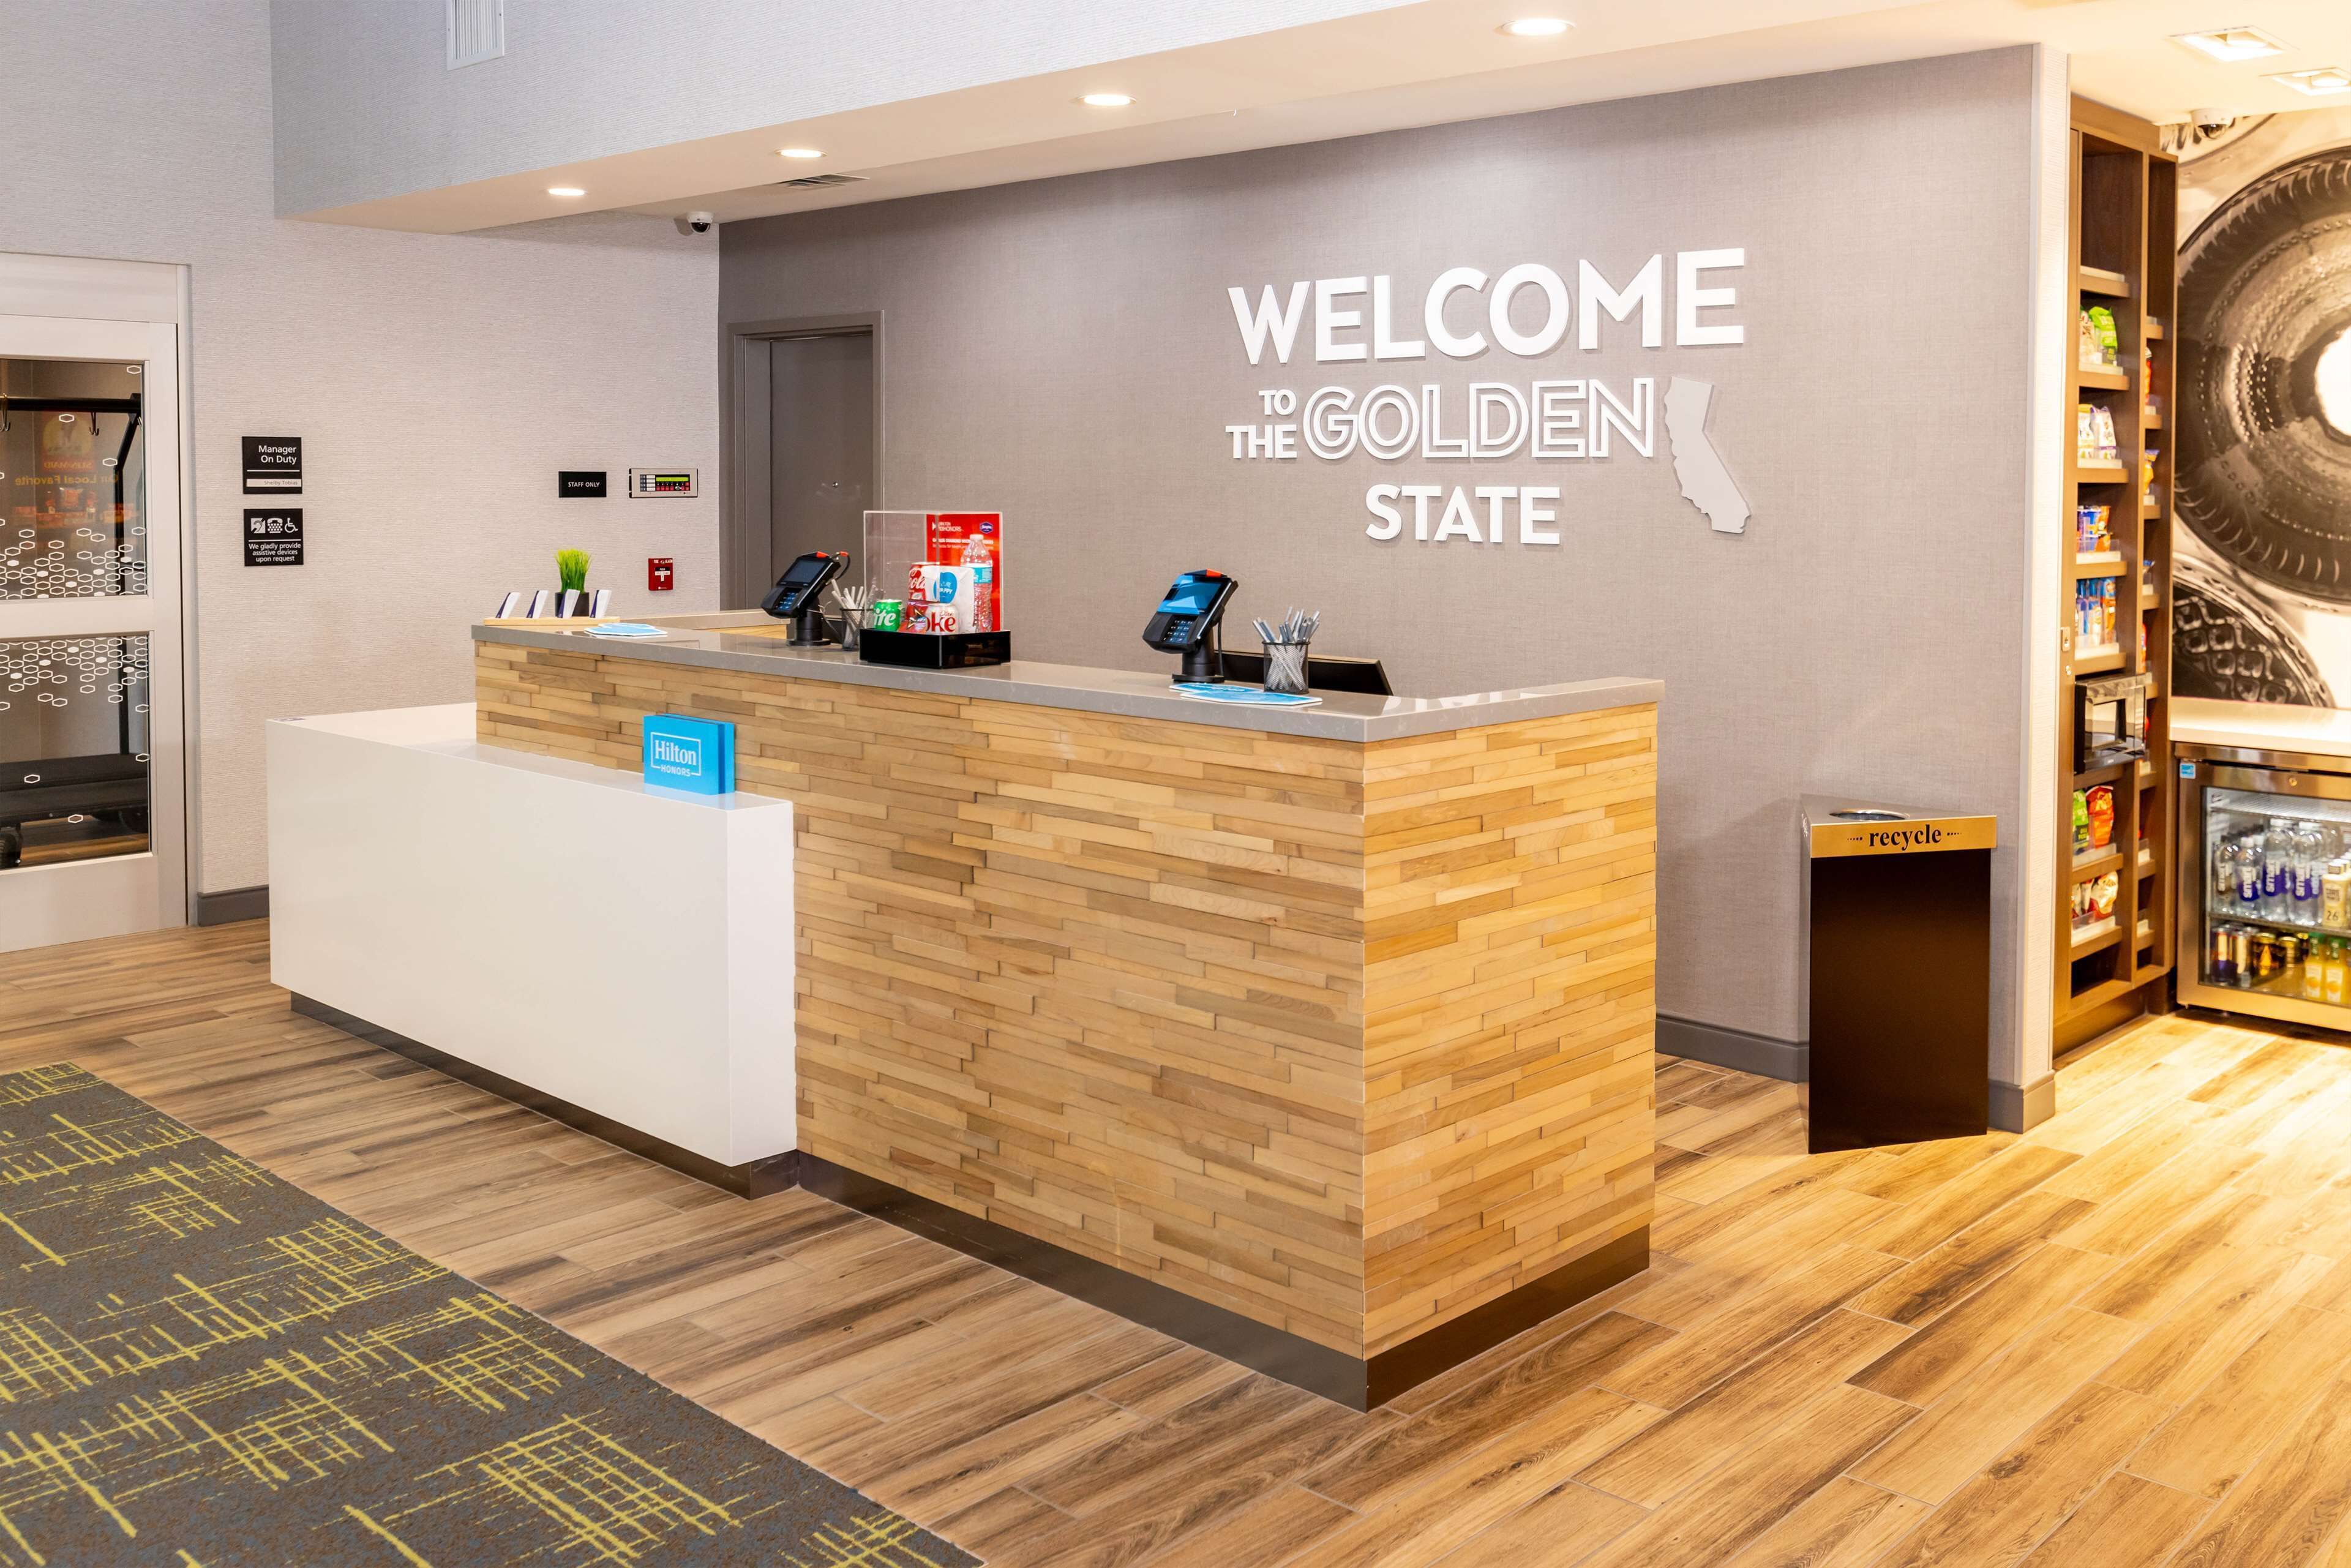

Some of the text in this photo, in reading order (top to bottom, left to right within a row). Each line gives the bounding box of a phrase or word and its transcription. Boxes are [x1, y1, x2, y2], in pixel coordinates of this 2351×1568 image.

[1227, 248, 1744, 366] WELCOME
[1258, 389, 1297, 416] TO
[1225, 377, 1654, 460] THE GOLDEN
[258, 445, 296, 455] Manager
[276, 455, 297, 465] Duty
[1365, 484, 1561, 545] STATE
[279, 542, 301, 551] provide
[654, 739, 697, 765] Hilton
[661, 764, 691, 777] HONORS
[1869, 824, 1942, 851] recycle
[2242, 867, 2252, 898] smart
[2266, 860, 2275, 893] smart
[2296, 862, 2306, 897] smart
